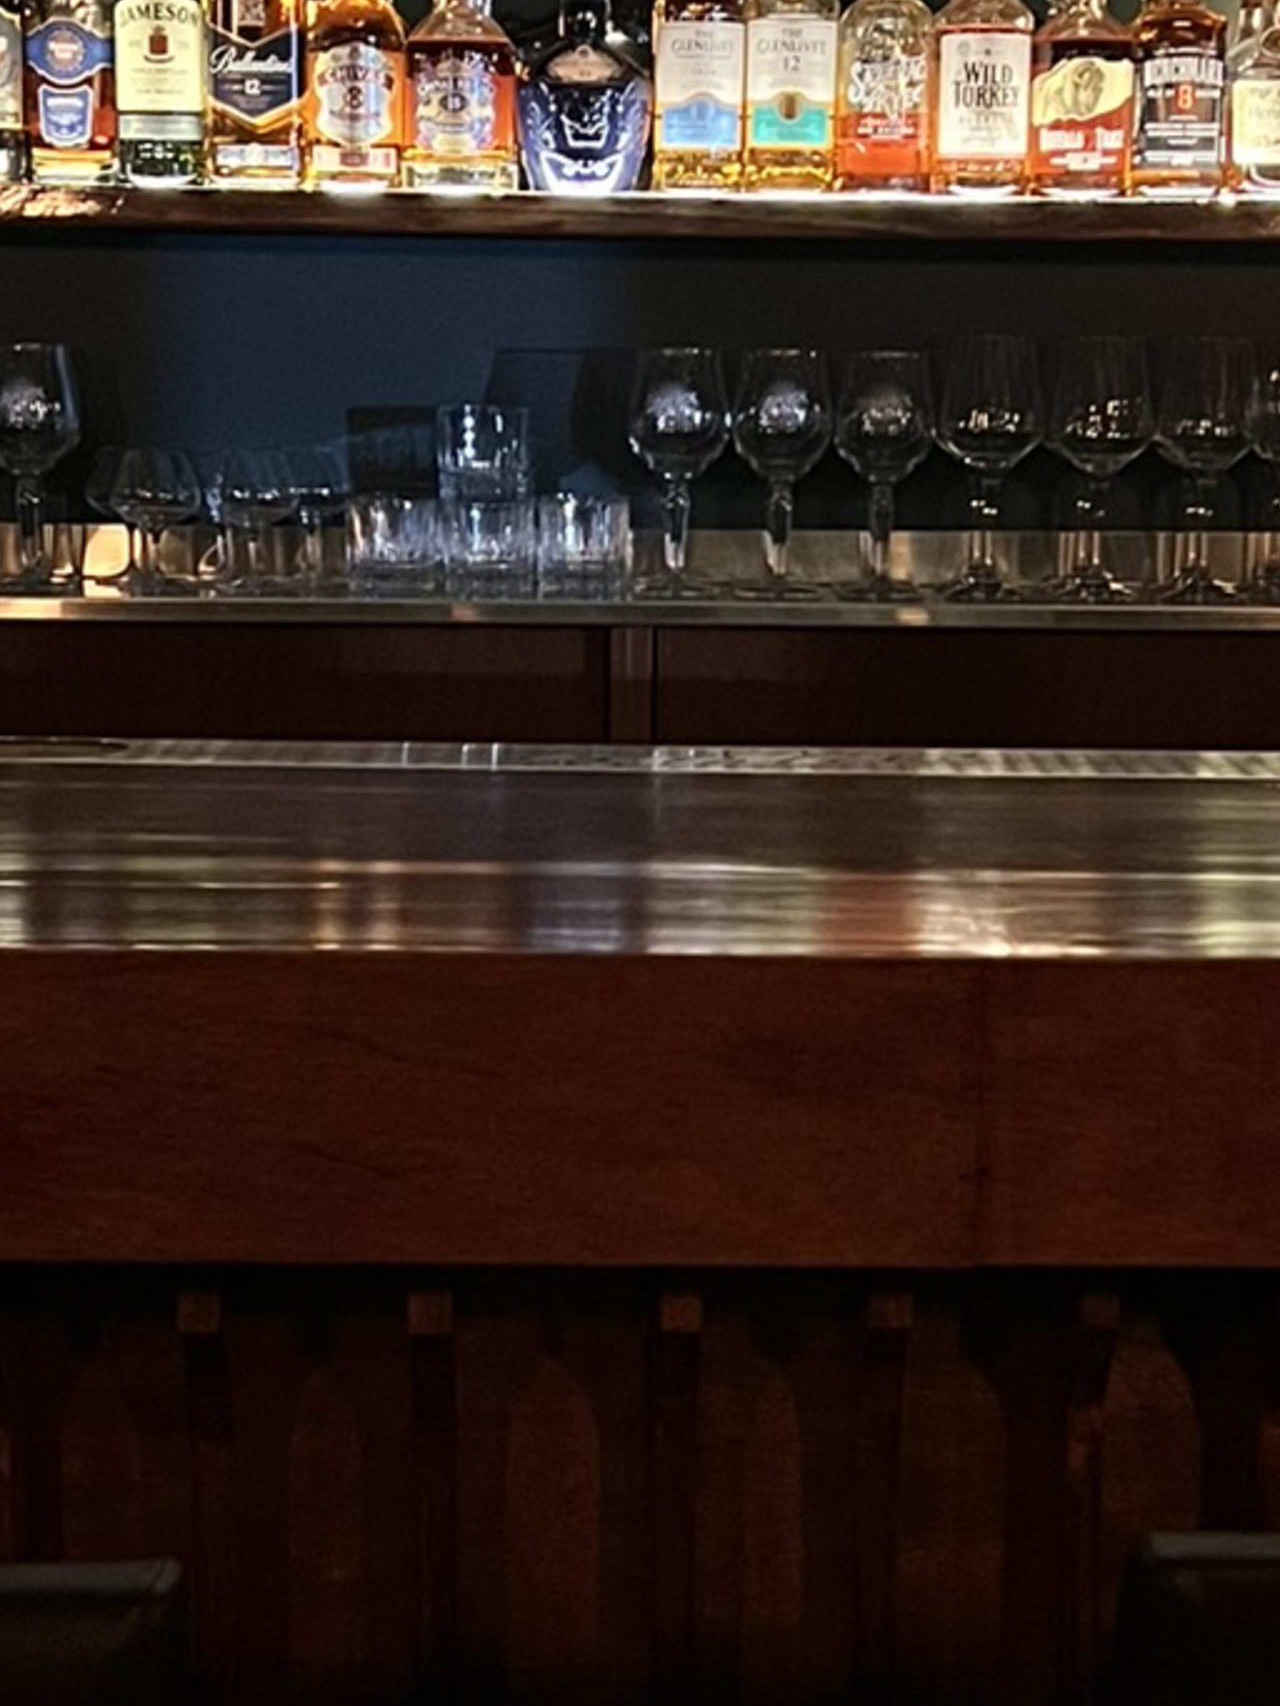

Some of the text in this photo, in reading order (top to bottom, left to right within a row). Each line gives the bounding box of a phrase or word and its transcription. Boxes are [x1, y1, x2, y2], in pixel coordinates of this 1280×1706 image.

[118, 1, 199, 27] JAMESON
[782, 55, 802, 73] 12
[963, 61, 1014, 85] WILD
[244, 78, 262, 95] 12
[953, 80, 1020, 108] TURKEY
